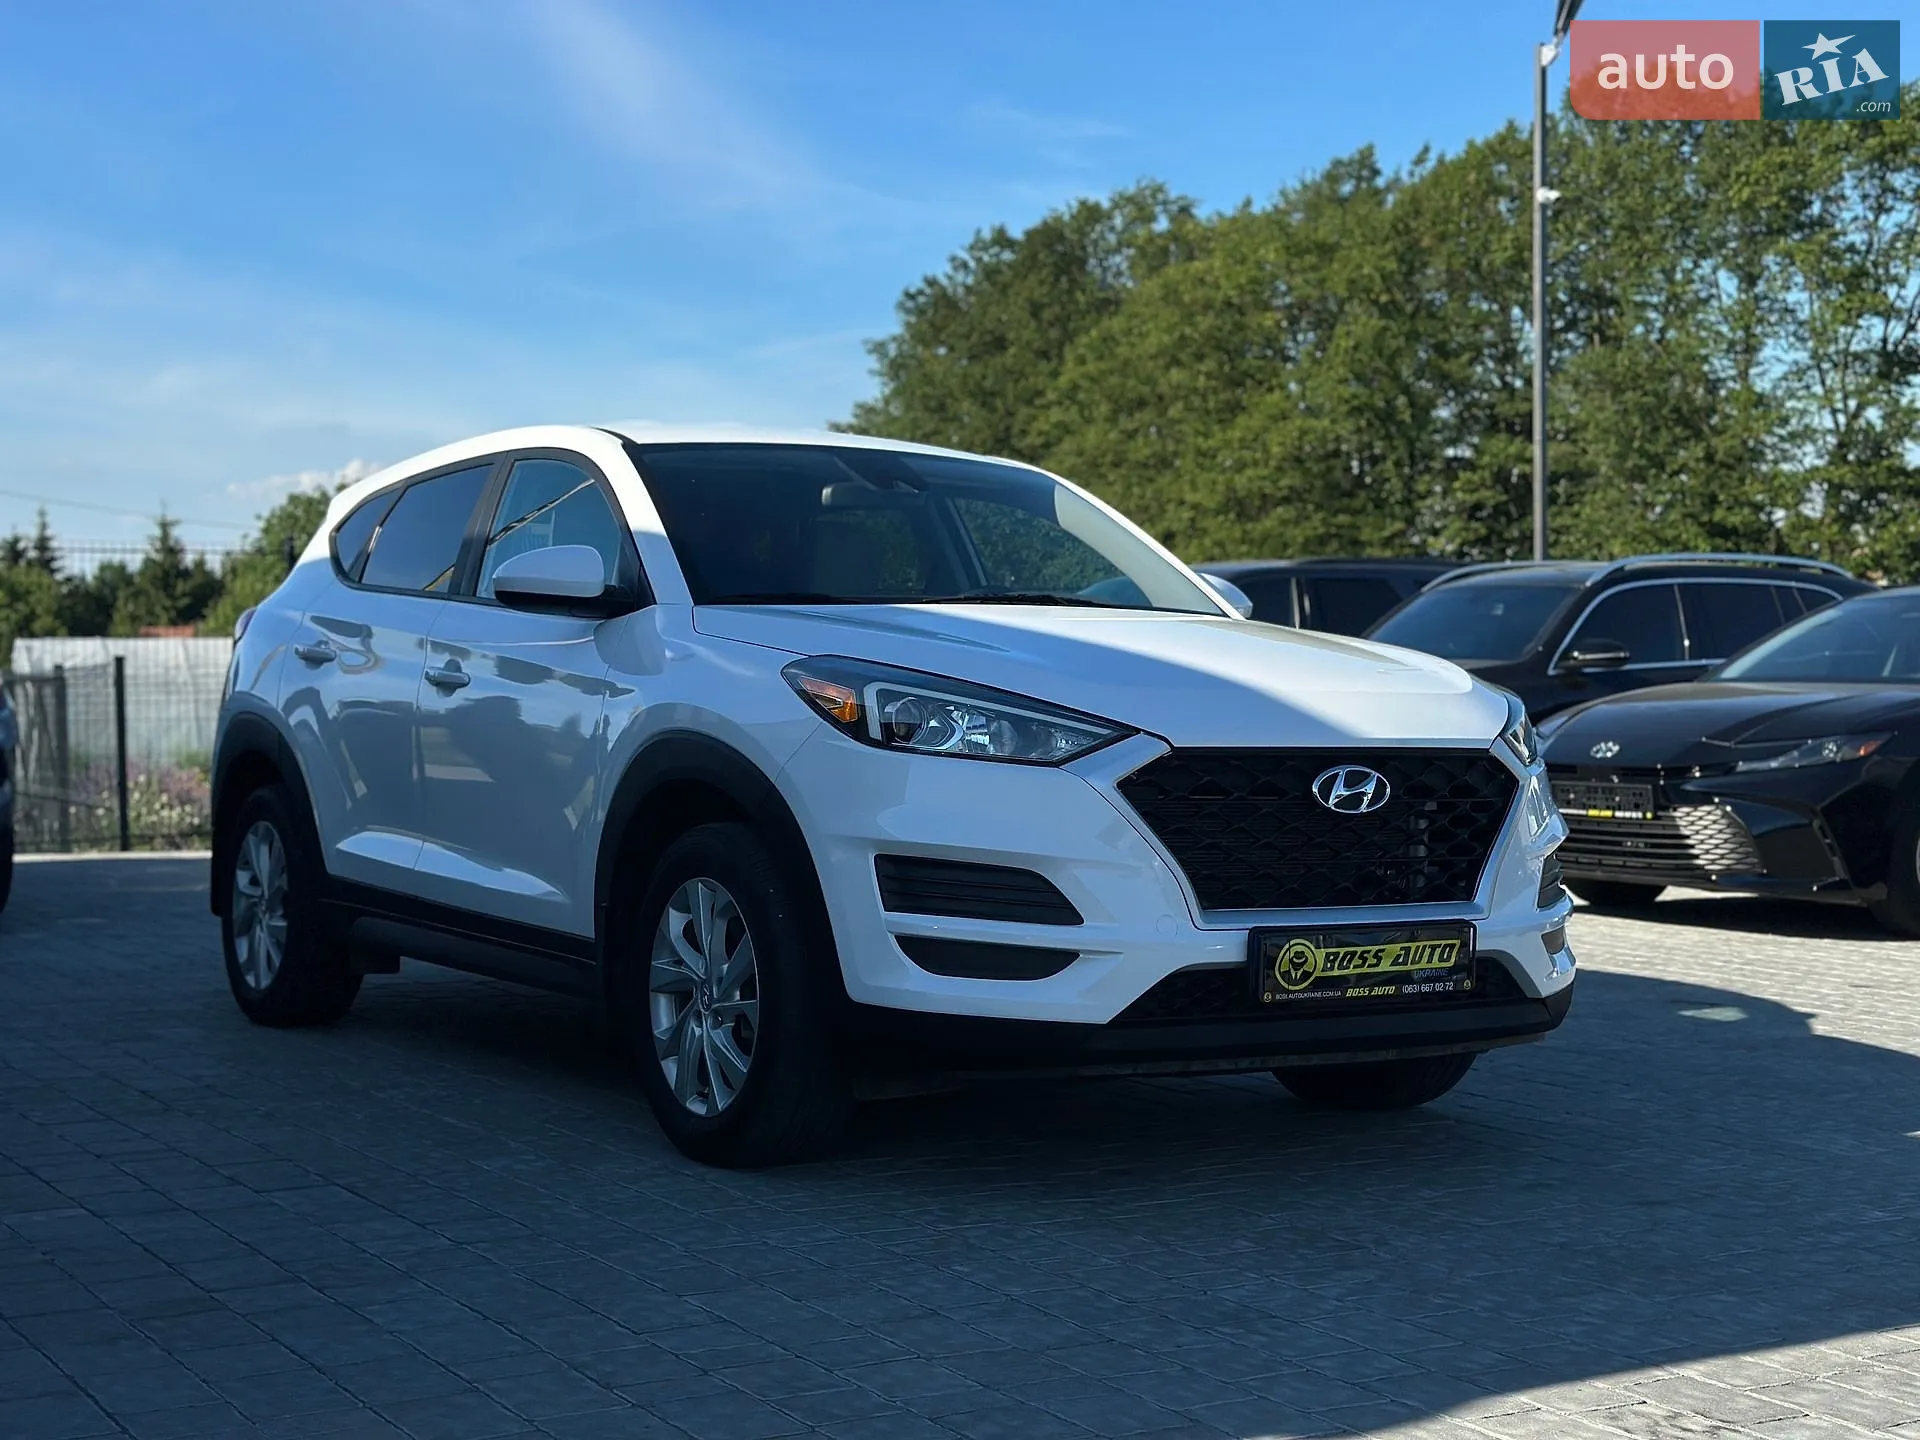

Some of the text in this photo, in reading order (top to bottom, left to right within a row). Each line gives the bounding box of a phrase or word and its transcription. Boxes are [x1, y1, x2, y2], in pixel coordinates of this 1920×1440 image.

[1321, 943, 1457, 973] BOSS AUTO
[1414, 968, 1449, 979] UKRAINE
[1346, 987, 1369, 997] BOSS
[1371, 986, 1396, 996] AUTO
[1435, 983, 1444, 992] 02
[1444, 982, 1454, 991] 72
